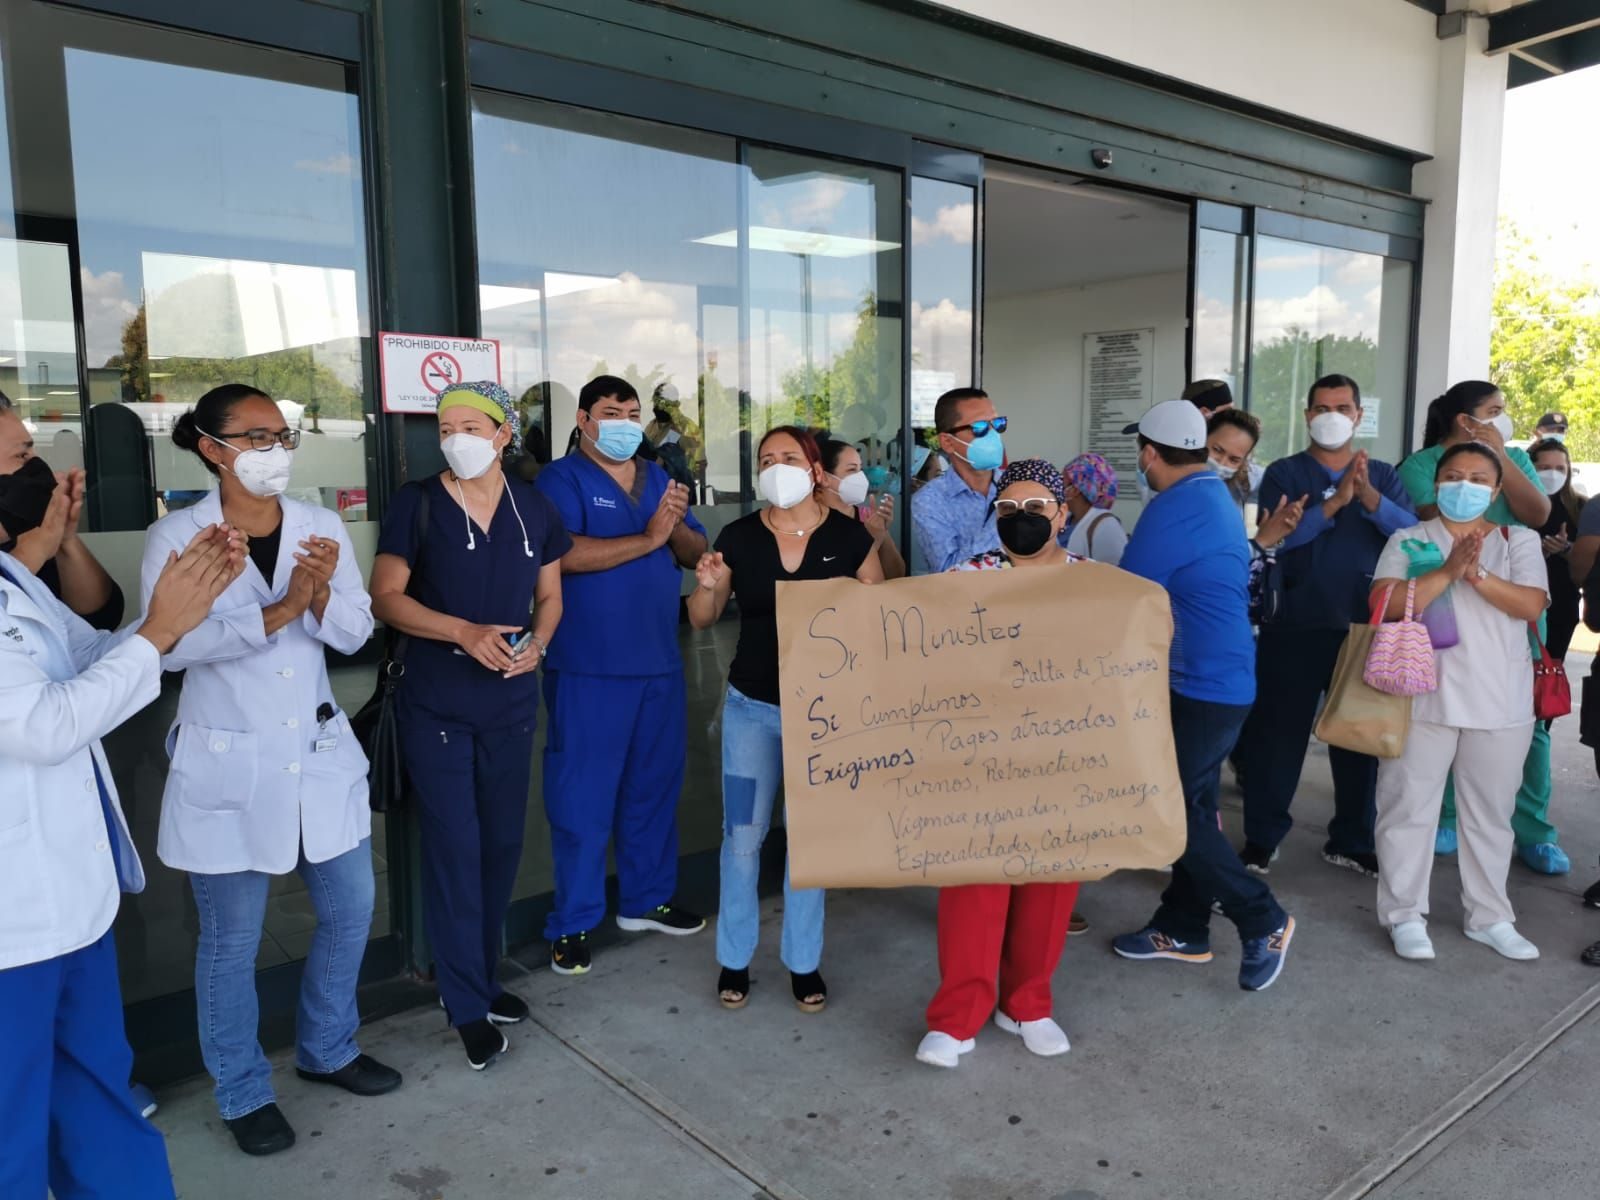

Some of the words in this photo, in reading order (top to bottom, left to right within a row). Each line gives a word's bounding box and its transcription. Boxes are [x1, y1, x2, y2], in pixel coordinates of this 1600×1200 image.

[809, 606, 863, 679] Sr.
[1011, 658, 1065, 689] Falta
[1073, 658, 1091, 680] de
[926, 719, 999, 766] Pagos
[1010, 704, 1117, 742] atrasados
[981, 749, 1109, 783] Retroactivos
